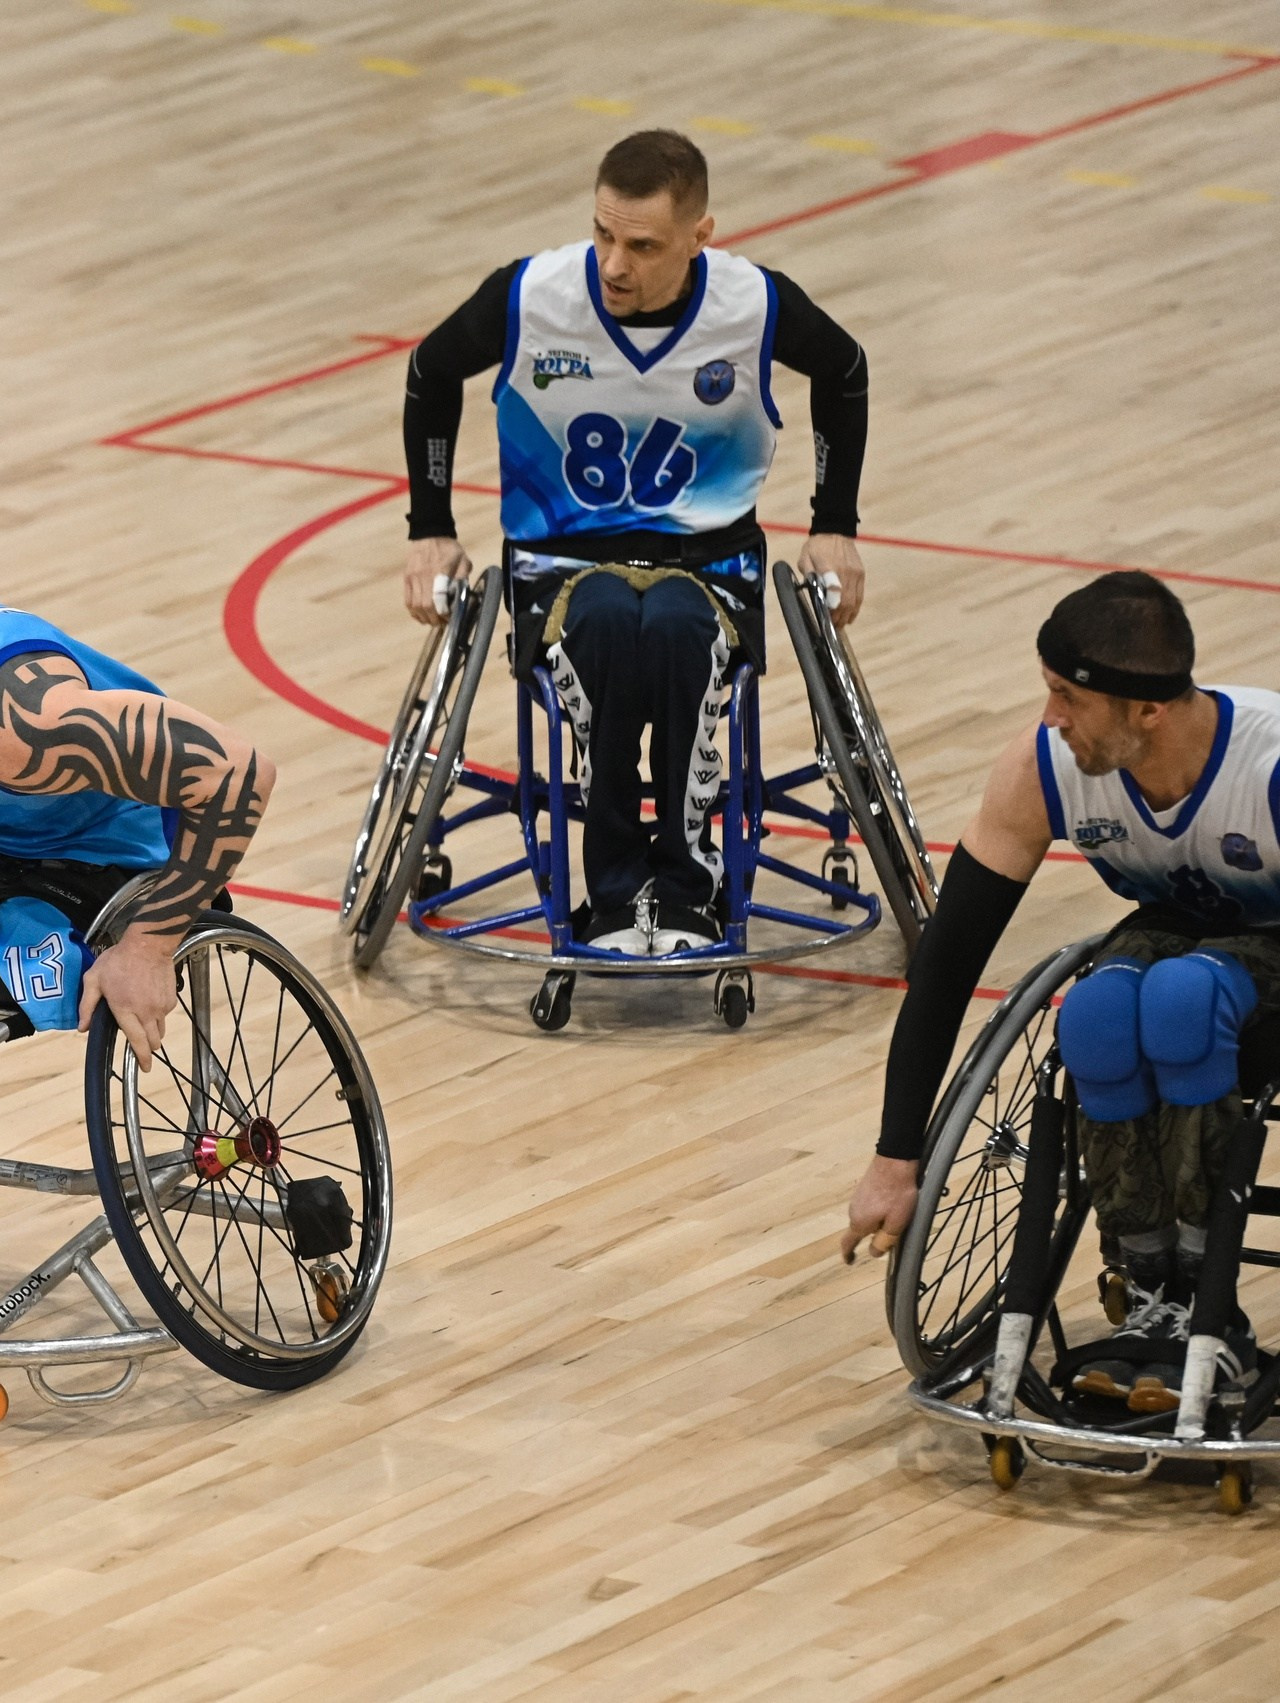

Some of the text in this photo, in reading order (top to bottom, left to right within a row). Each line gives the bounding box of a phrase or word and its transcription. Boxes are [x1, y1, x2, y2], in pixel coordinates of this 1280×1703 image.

[533, 357, 594, 380] ЮГРА
[562, 411, 697, 516] 86
[3, 932, 65, 1004] 13
